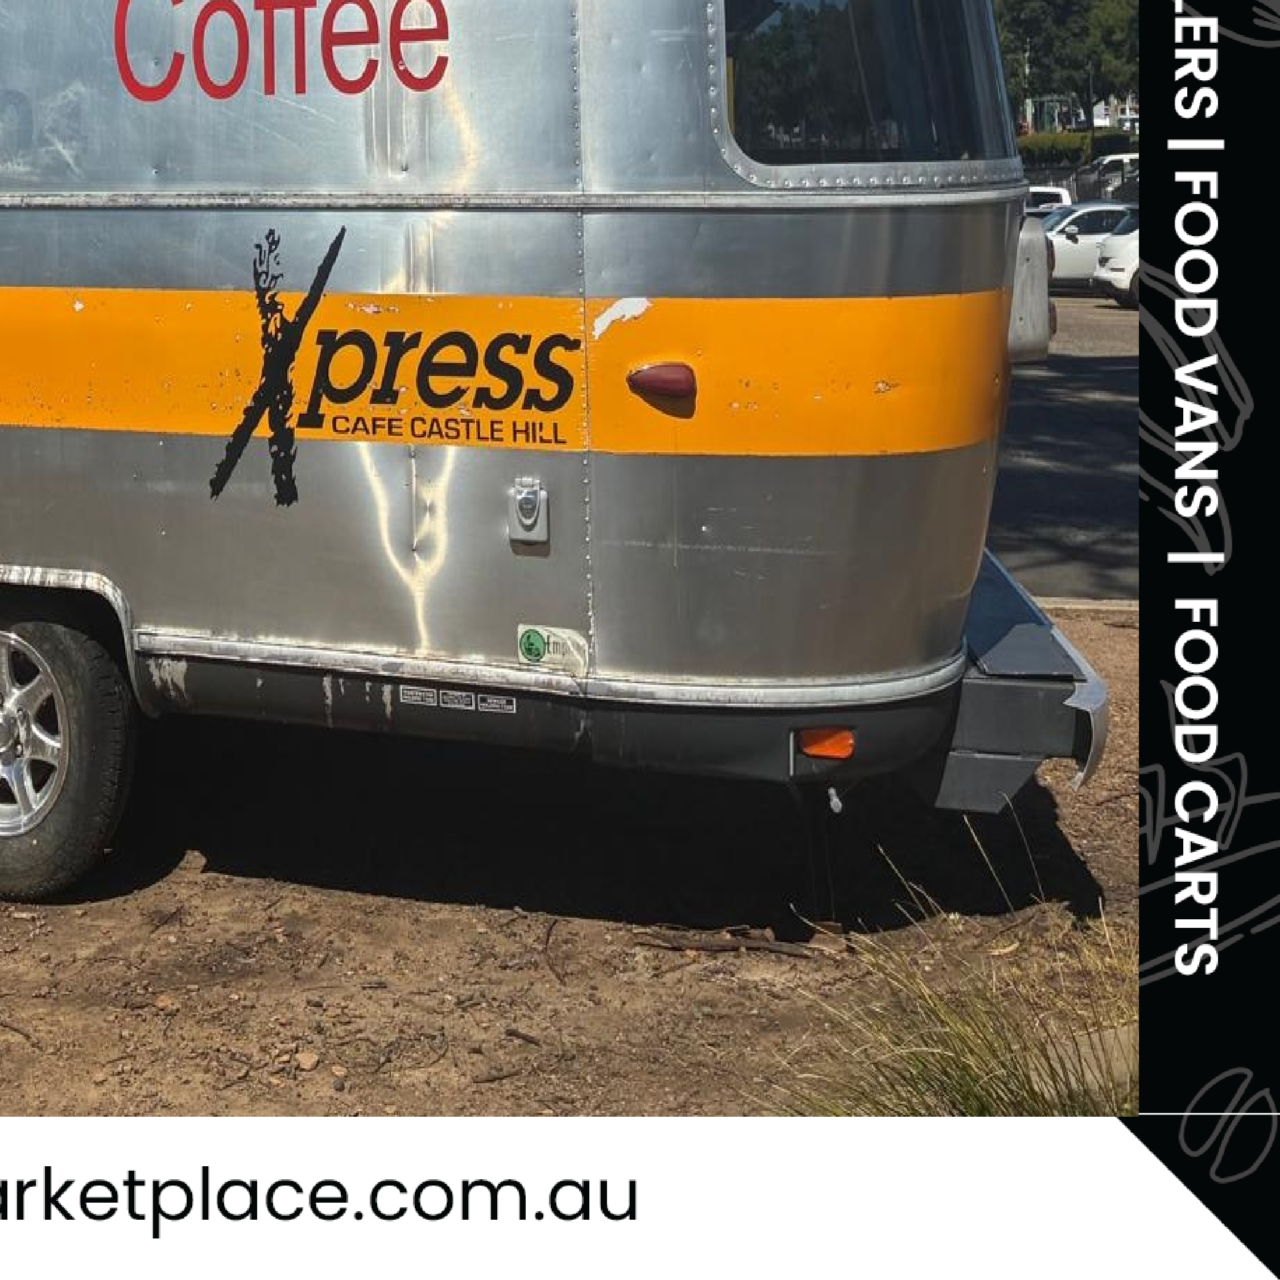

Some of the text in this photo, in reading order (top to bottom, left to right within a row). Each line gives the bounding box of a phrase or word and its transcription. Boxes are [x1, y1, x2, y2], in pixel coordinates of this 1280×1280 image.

[209, 225, 581, 507] Xpress
[332, 416, 567, 444] CAFE CASTLE HILL
